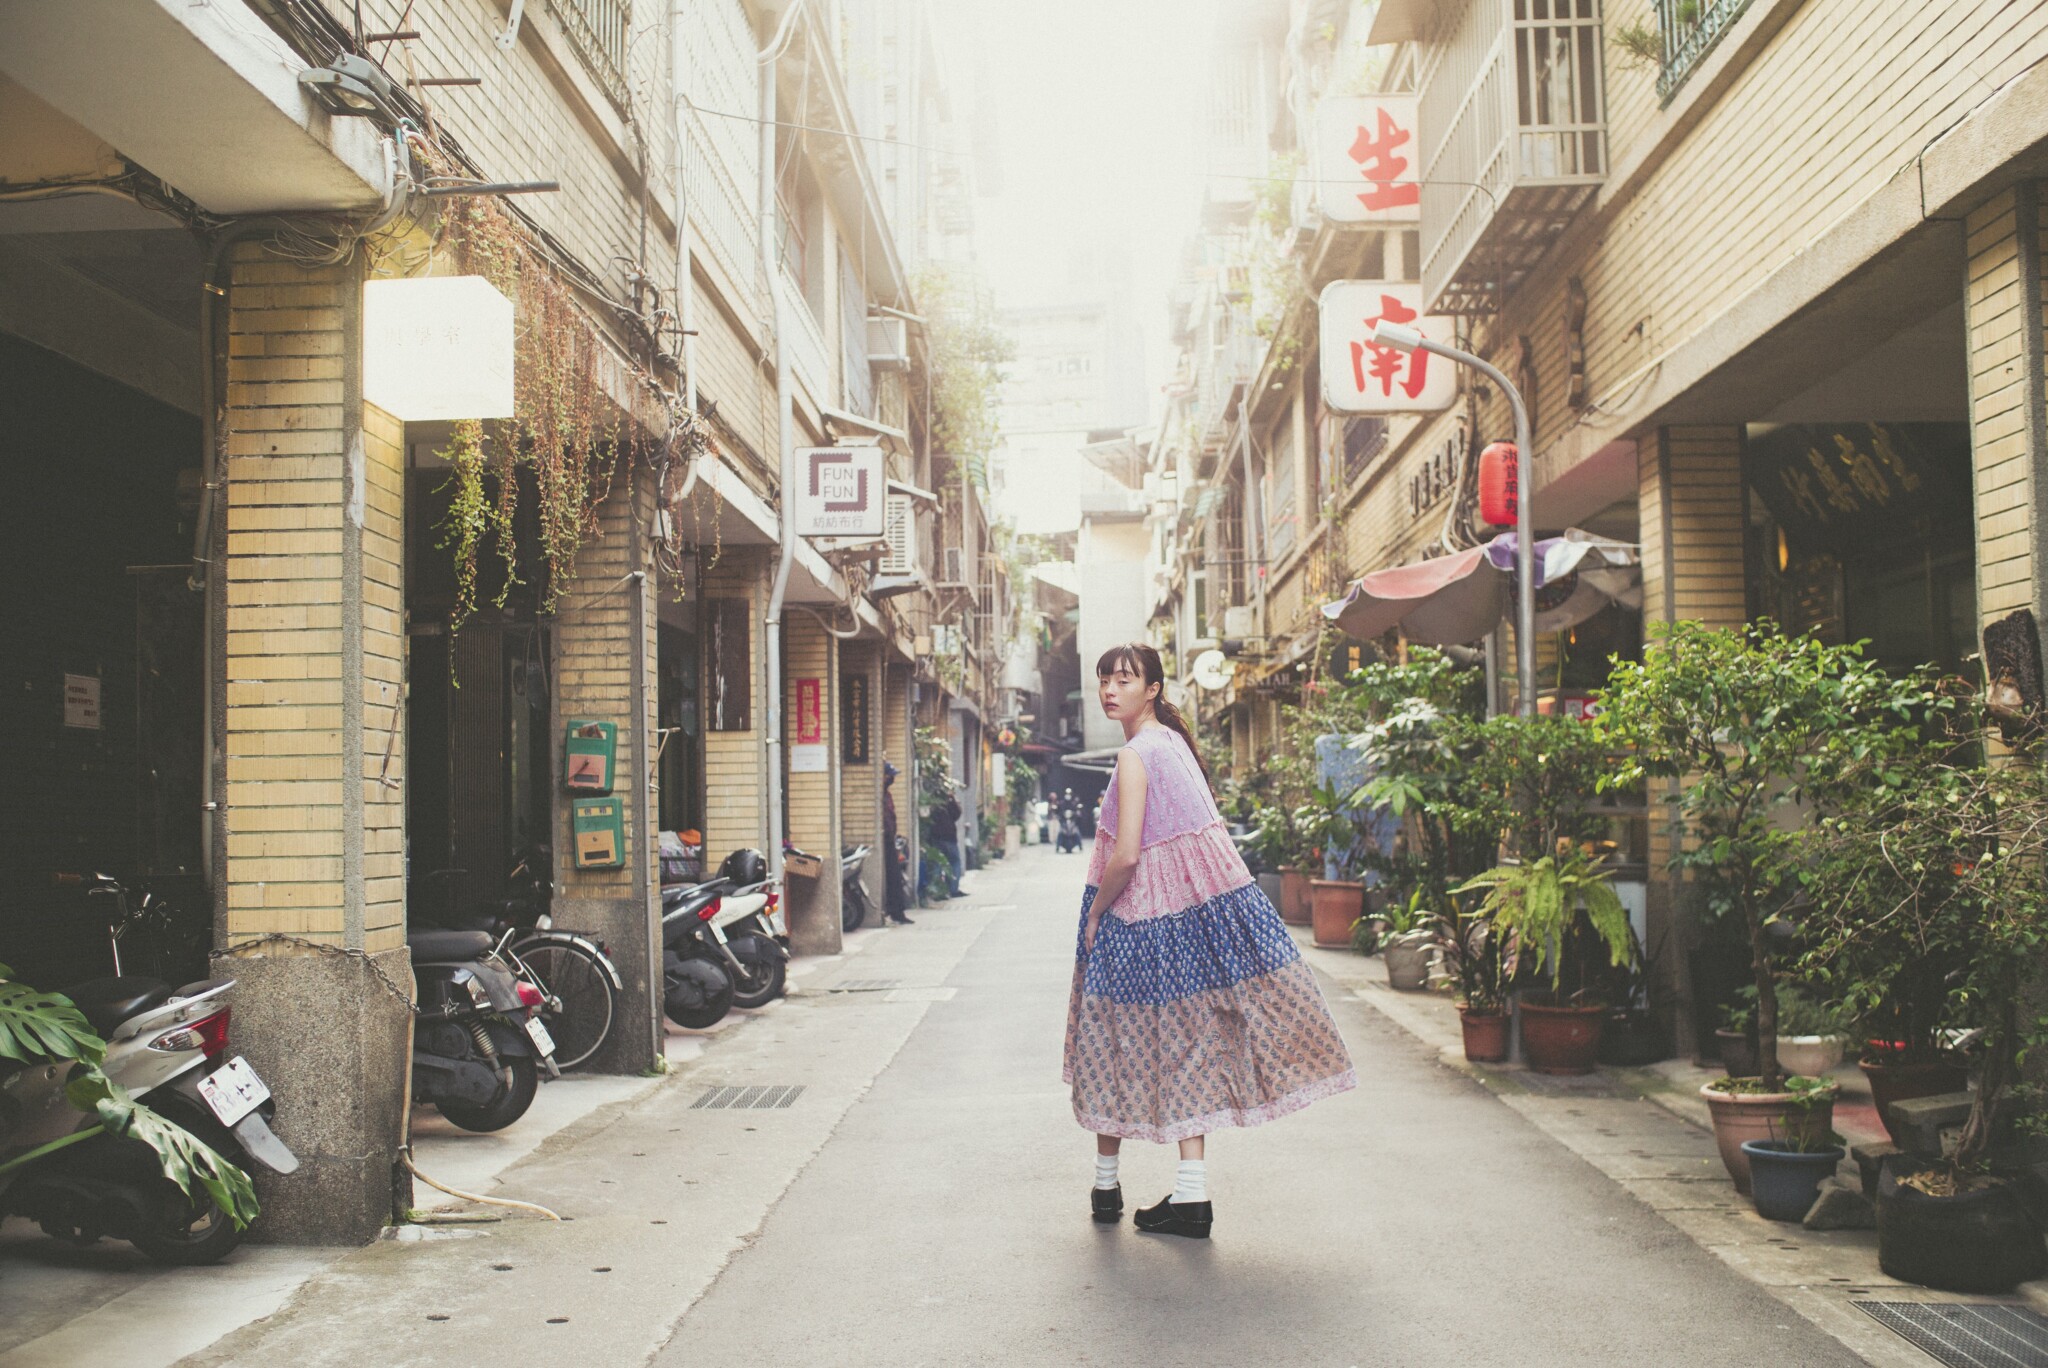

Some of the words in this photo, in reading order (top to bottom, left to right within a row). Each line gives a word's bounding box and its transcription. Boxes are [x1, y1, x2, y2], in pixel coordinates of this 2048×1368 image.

[1348, 107, 1421, 211] 生
[1350, 295, 1429, 399] 南
[823, 467, 854, 481] FUN
[823, 485, 854, 499] FUN
[813, 515, 864, 528] 紡紡布行
